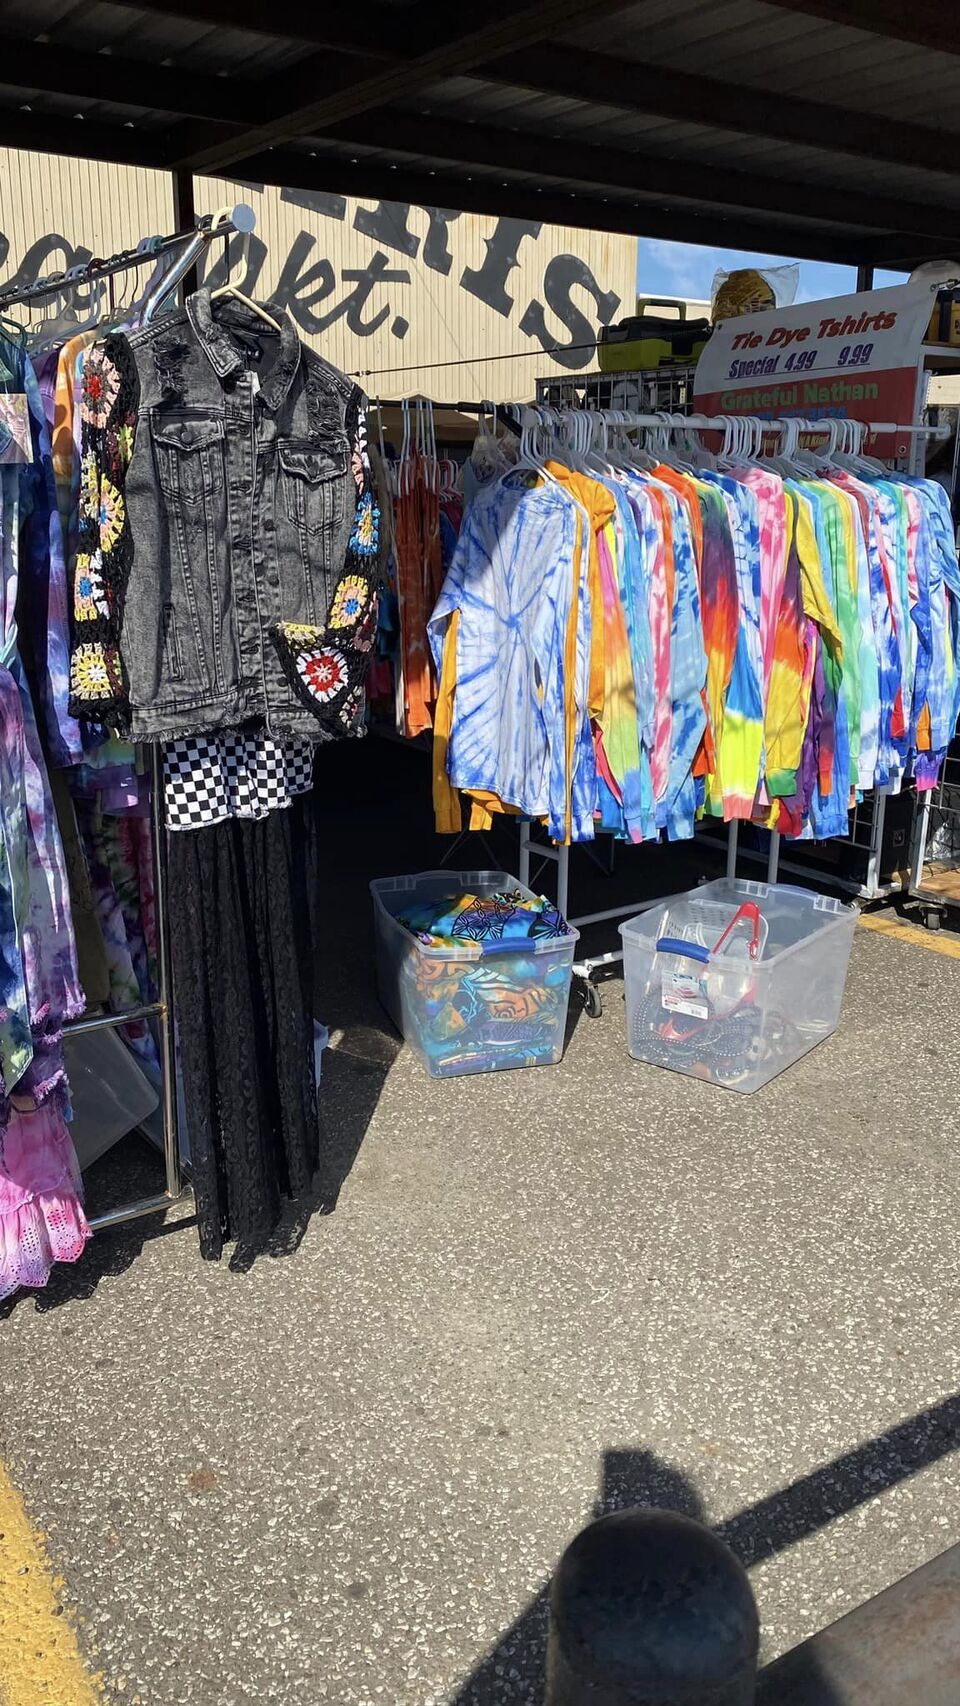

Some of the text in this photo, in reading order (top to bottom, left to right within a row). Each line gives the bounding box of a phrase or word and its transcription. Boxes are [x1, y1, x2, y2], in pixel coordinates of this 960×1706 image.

[731, 311, 898, 350] Tie Dye Tshirts
[729, 343, 874, 378] Special 4.99 9.99
[721, 381, 879, 411] Grateful Nathan
